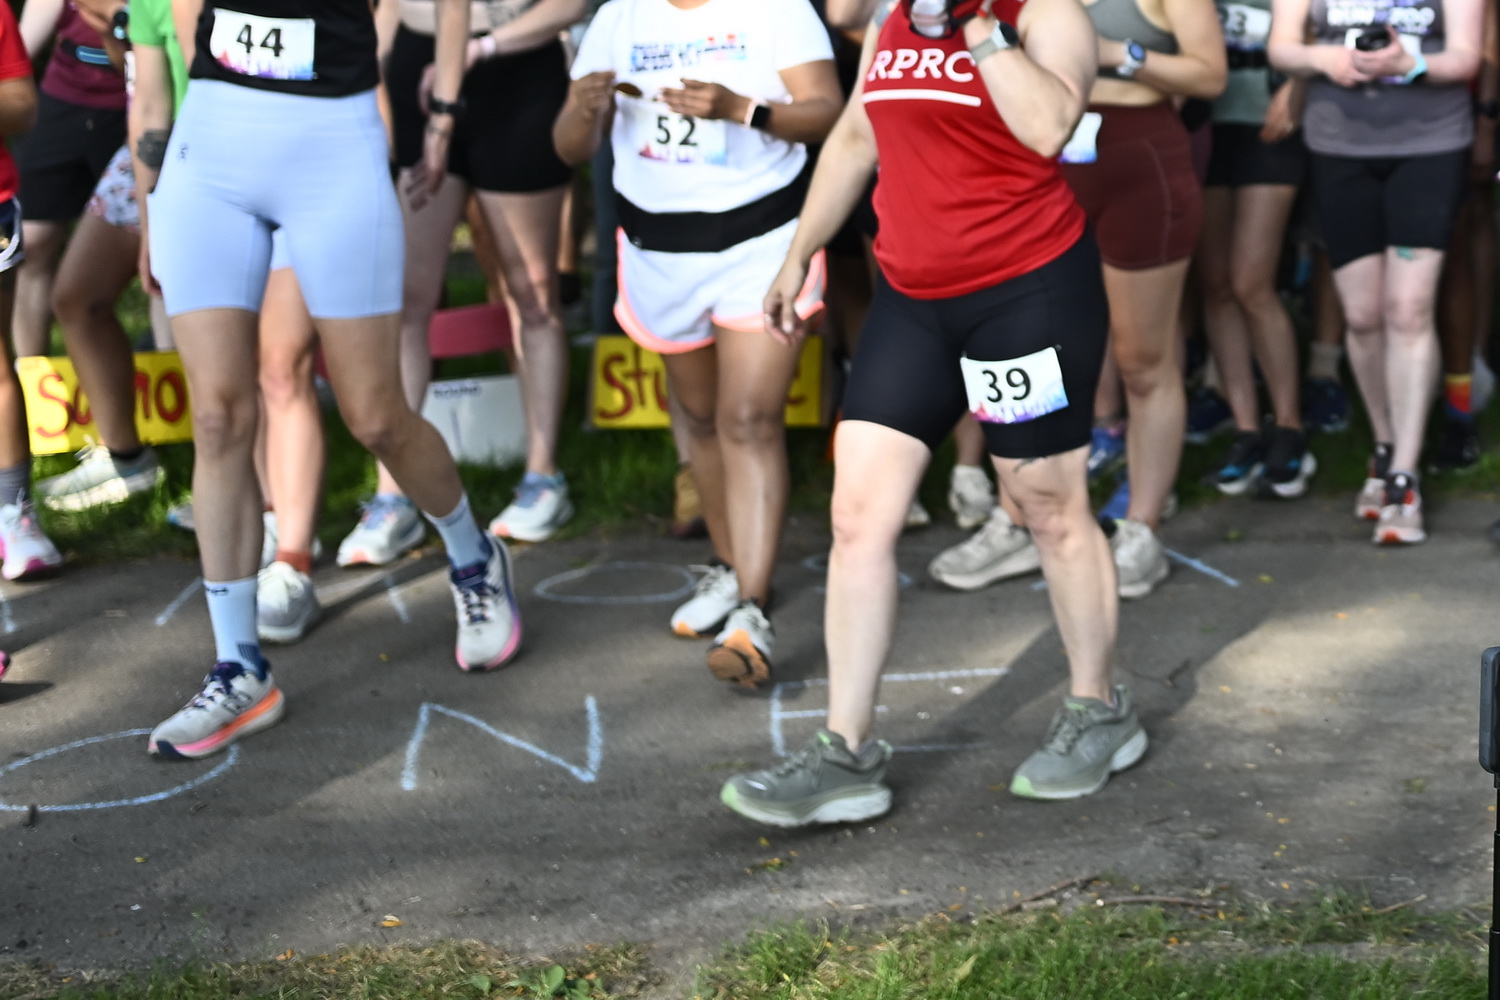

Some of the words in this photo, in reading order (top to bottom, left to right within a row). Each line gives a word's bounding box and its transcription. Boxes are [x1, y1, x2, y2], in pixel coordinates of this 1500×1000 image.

[236, 23, 285, 58] 44
[867, 47, 977, 83] RPRC
[656, 115, 698, 146] 52
[981, 367, 1032, 404] 39
